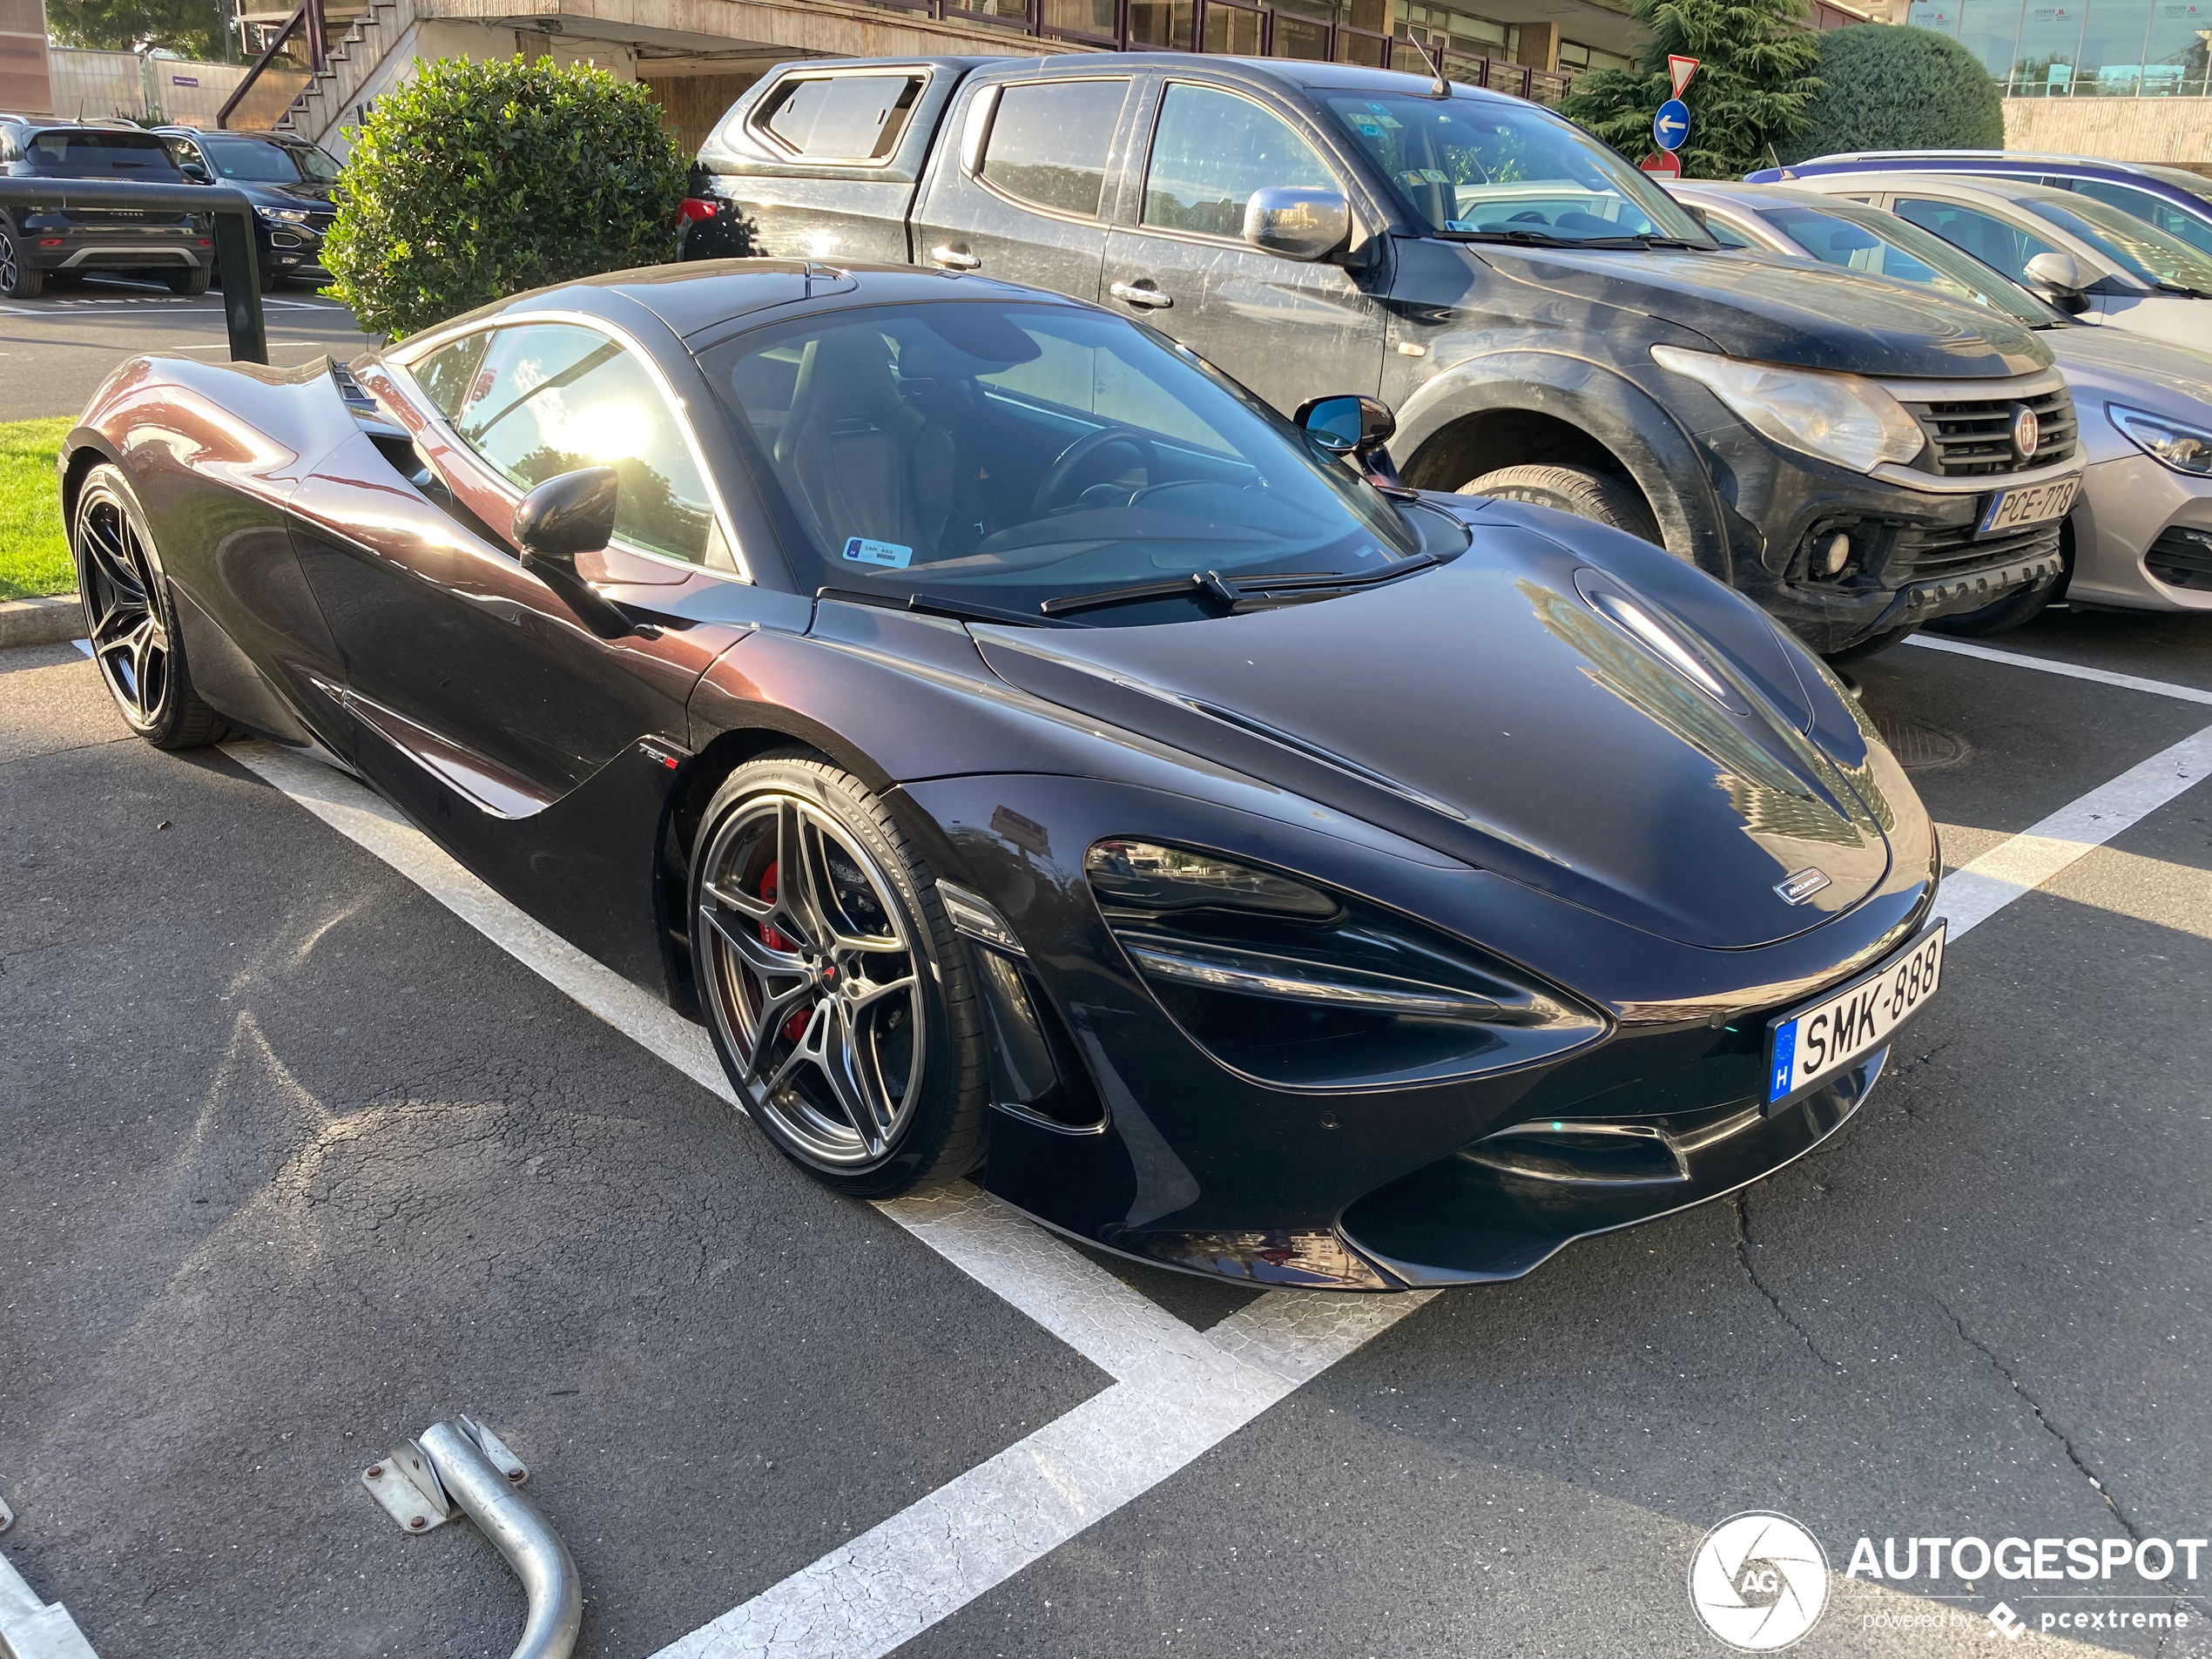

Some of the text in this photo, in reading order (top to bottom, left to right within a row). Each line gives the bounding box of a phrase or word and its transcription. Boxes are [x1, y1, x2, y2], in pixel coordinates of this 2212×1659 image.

[1994, 482, 2074, 526] PCE-778
[638, 742, 678, 770] 720S
[842, 806, 910, 898] 245/35 ZR19
[1789, 876, 1821, 896] McLaren
[1803, 939, 1937, 1075] SMK-888
[1776, 1069, 1788, 1090] H
